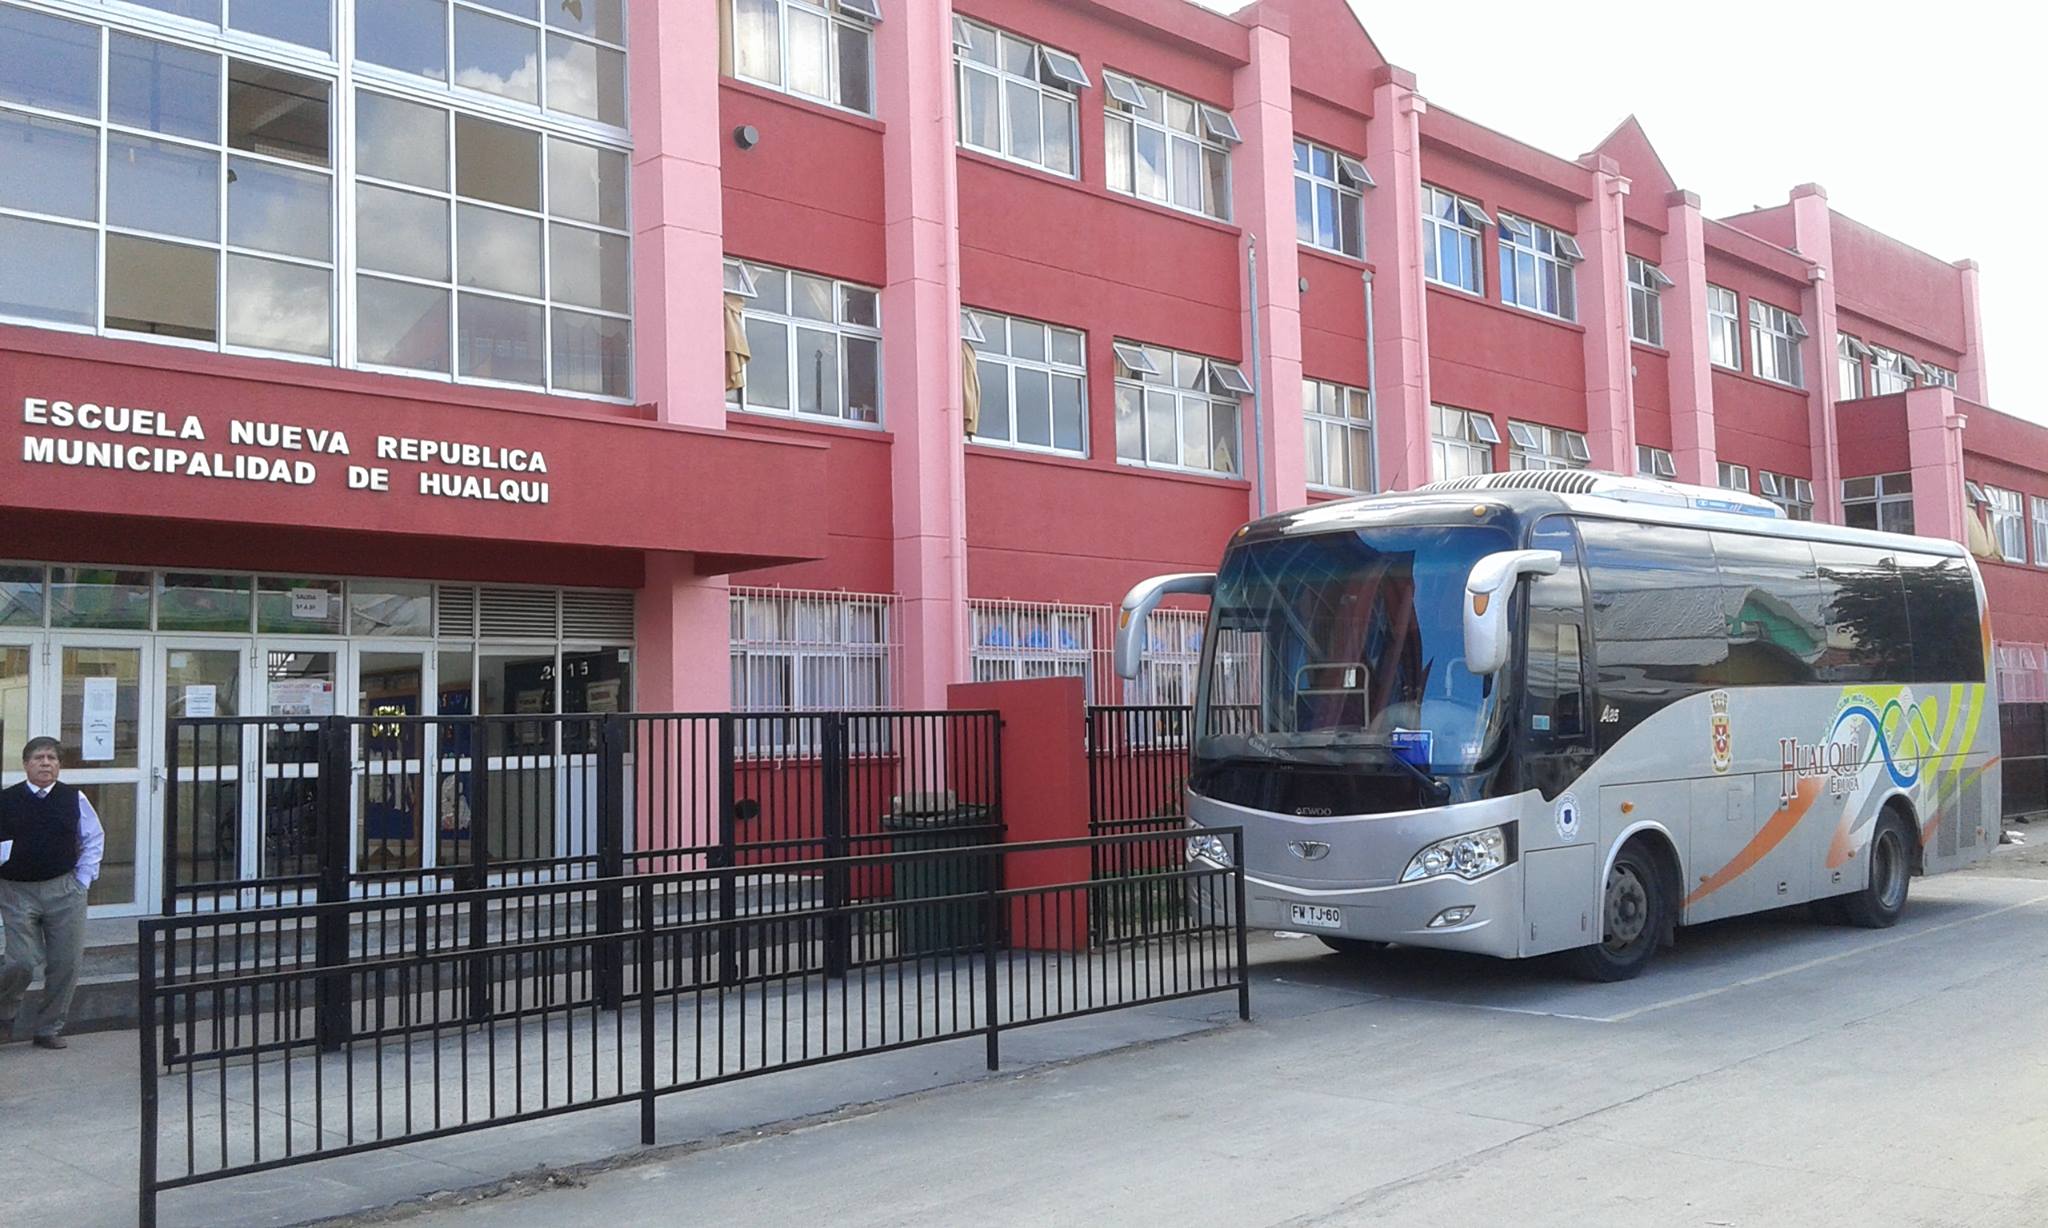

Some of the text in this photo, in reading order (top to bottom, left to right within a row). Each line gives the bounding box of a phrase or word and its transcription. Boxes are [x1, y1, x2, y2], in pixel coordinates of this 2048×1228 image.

[24, 397, 548, 474] ESCUELA NUEVA REPUBLICA
[23, 436, 549, 504] MUNICIPALIDAD DE HUALQUI
[1780, 739, 1859, 797] HUALQUI
[1830, 774, 1860, 795] EDUCA
